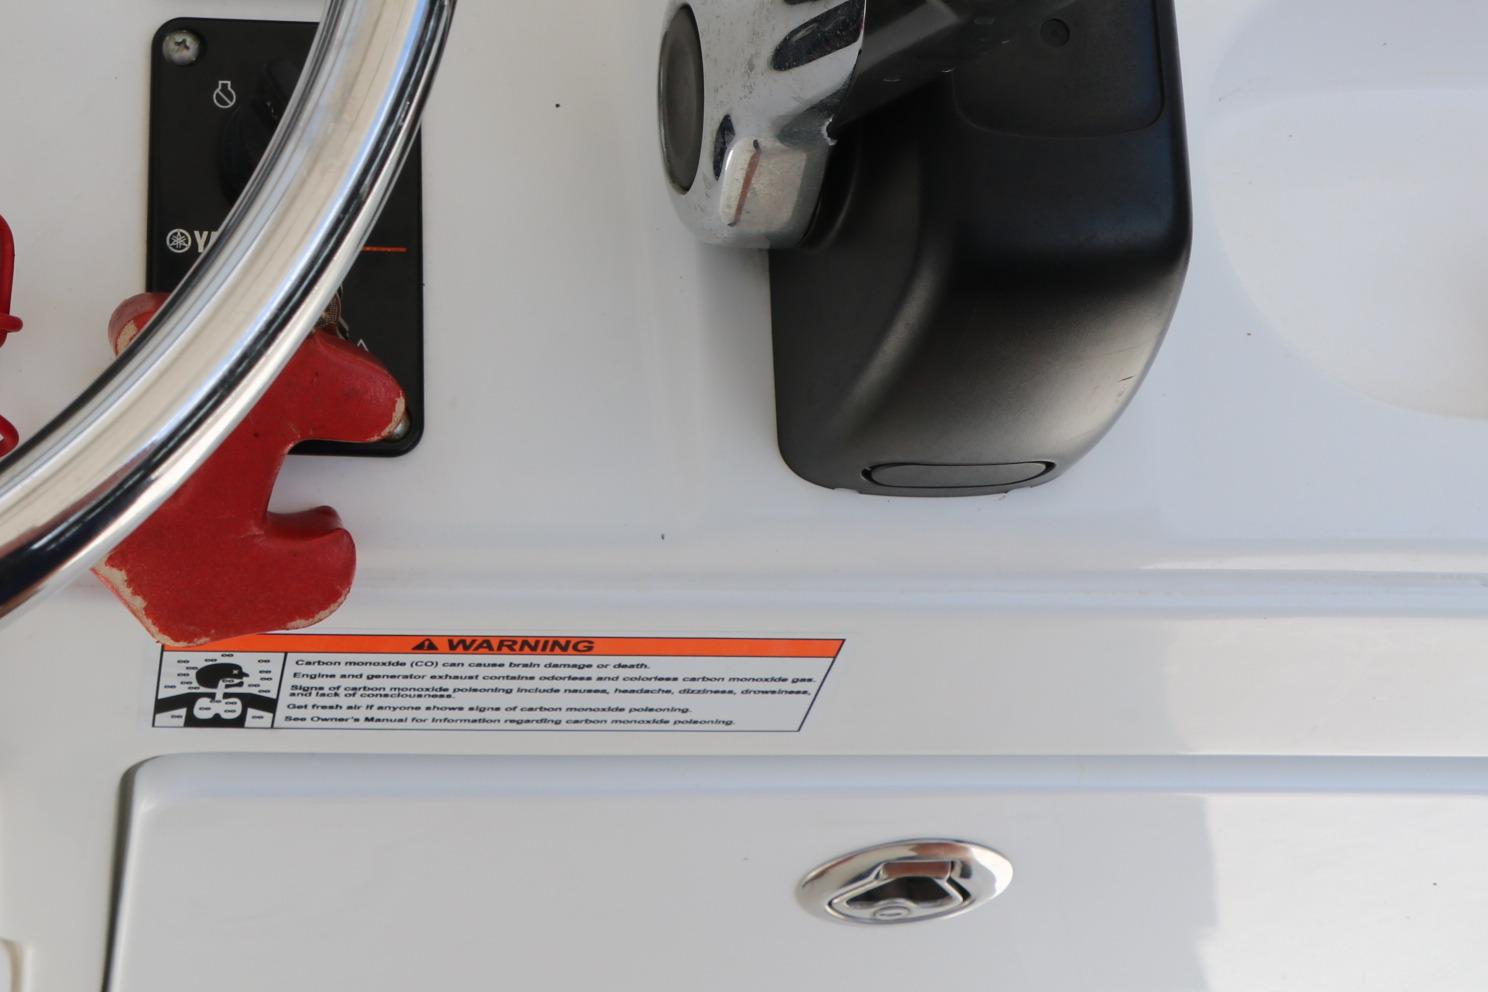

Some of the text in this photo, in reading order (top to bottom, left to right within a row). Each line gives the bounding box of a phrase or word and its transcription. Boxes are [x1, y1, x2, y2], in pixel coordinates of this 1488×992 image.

[447, 638, 596, 653] WARNING
[294, 658, 342, 666] Carbon
[344, 659, 407, 667] monoxide
[409, 660, 439, 668] (CO)
[543, 662, 593, 670] damage
